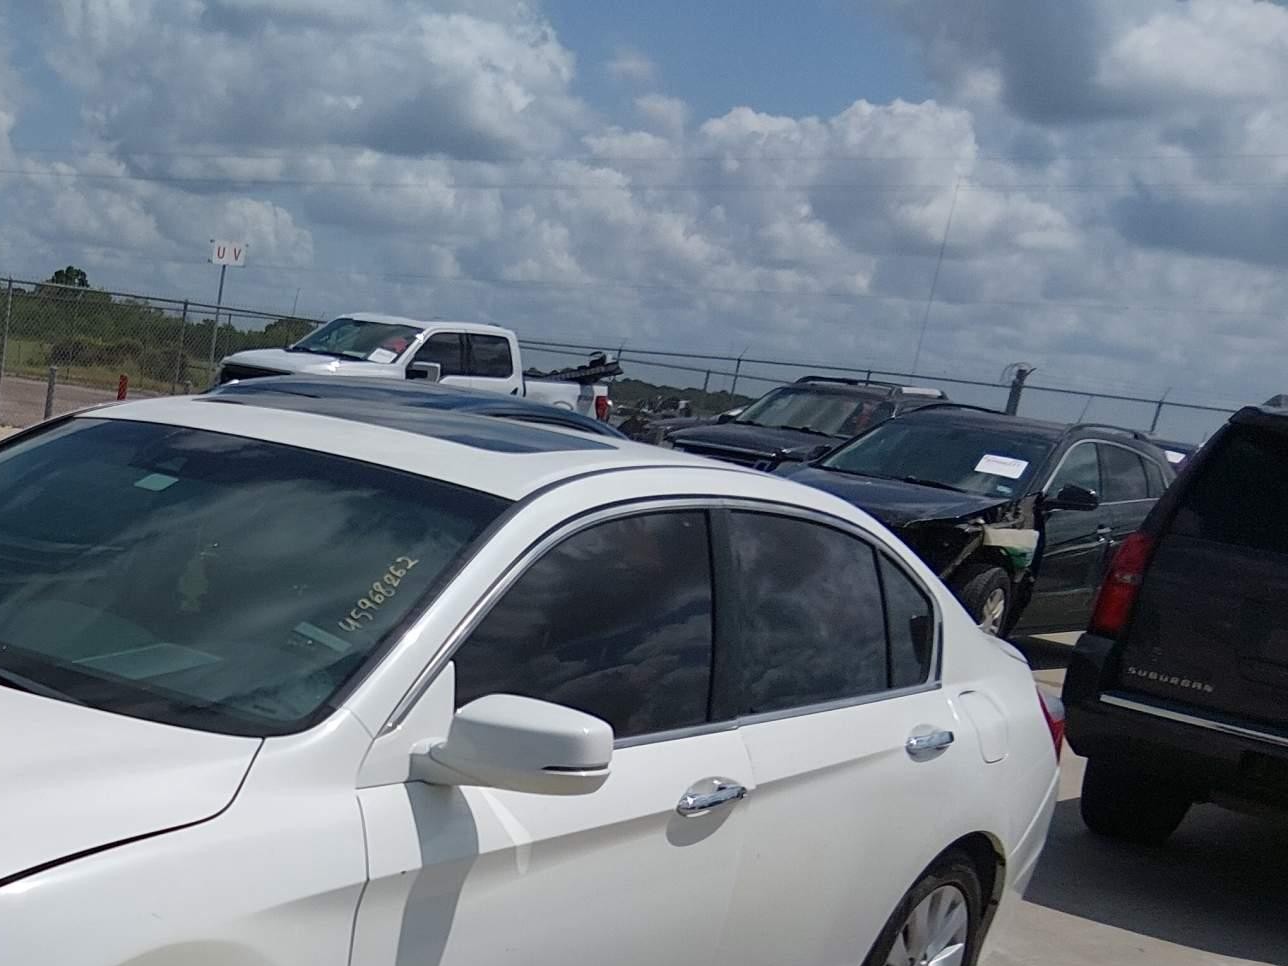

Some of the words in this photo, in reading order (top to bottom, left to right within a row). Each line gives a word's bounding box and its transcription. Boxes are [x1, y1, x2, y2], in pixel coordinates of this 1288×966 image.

[217, 246, 226, 260] U
[233, 248, 242, 261] V
[337, 555, 420, 632] 45968262
[1126, 665, 1215, 693] SUBURBAN
